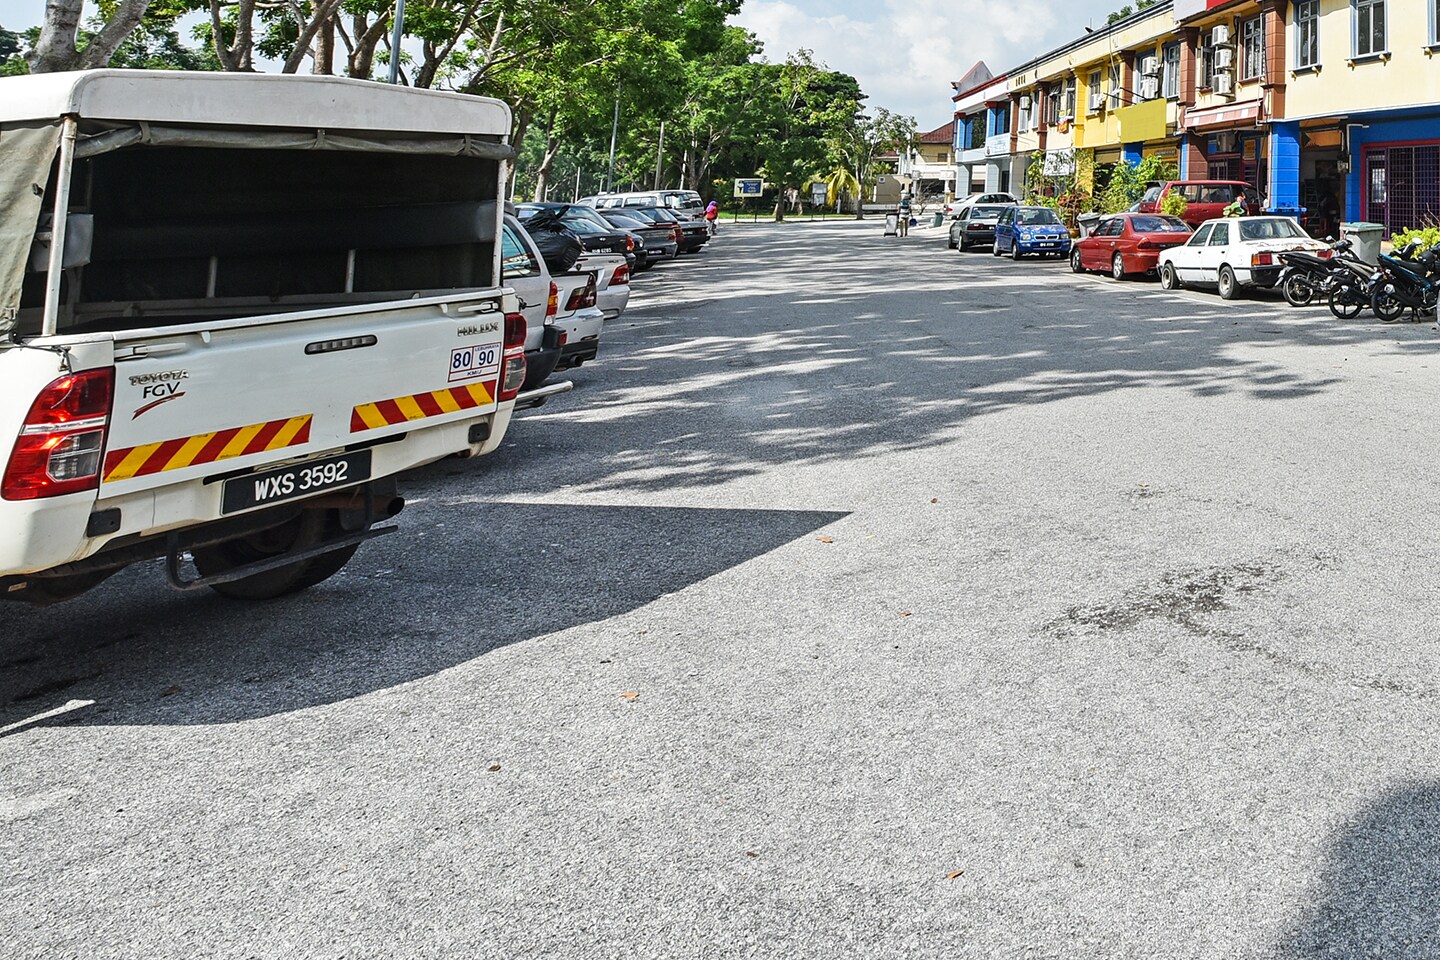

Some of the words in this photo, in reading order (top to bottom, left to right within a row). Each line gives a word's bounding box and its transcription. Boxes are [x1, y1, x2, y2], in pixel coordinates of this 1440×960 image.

[456, 321, 499, 337] HILUX
[452, 350, 471, 369] 80
[478, 350, 495, 366] 90
[128, 368, 190, 386] TOYOTA
[142, 381, 181, 400] FGV
[254, 472, 296, 501] WXS
[299, 460, 349, 490] 3592
